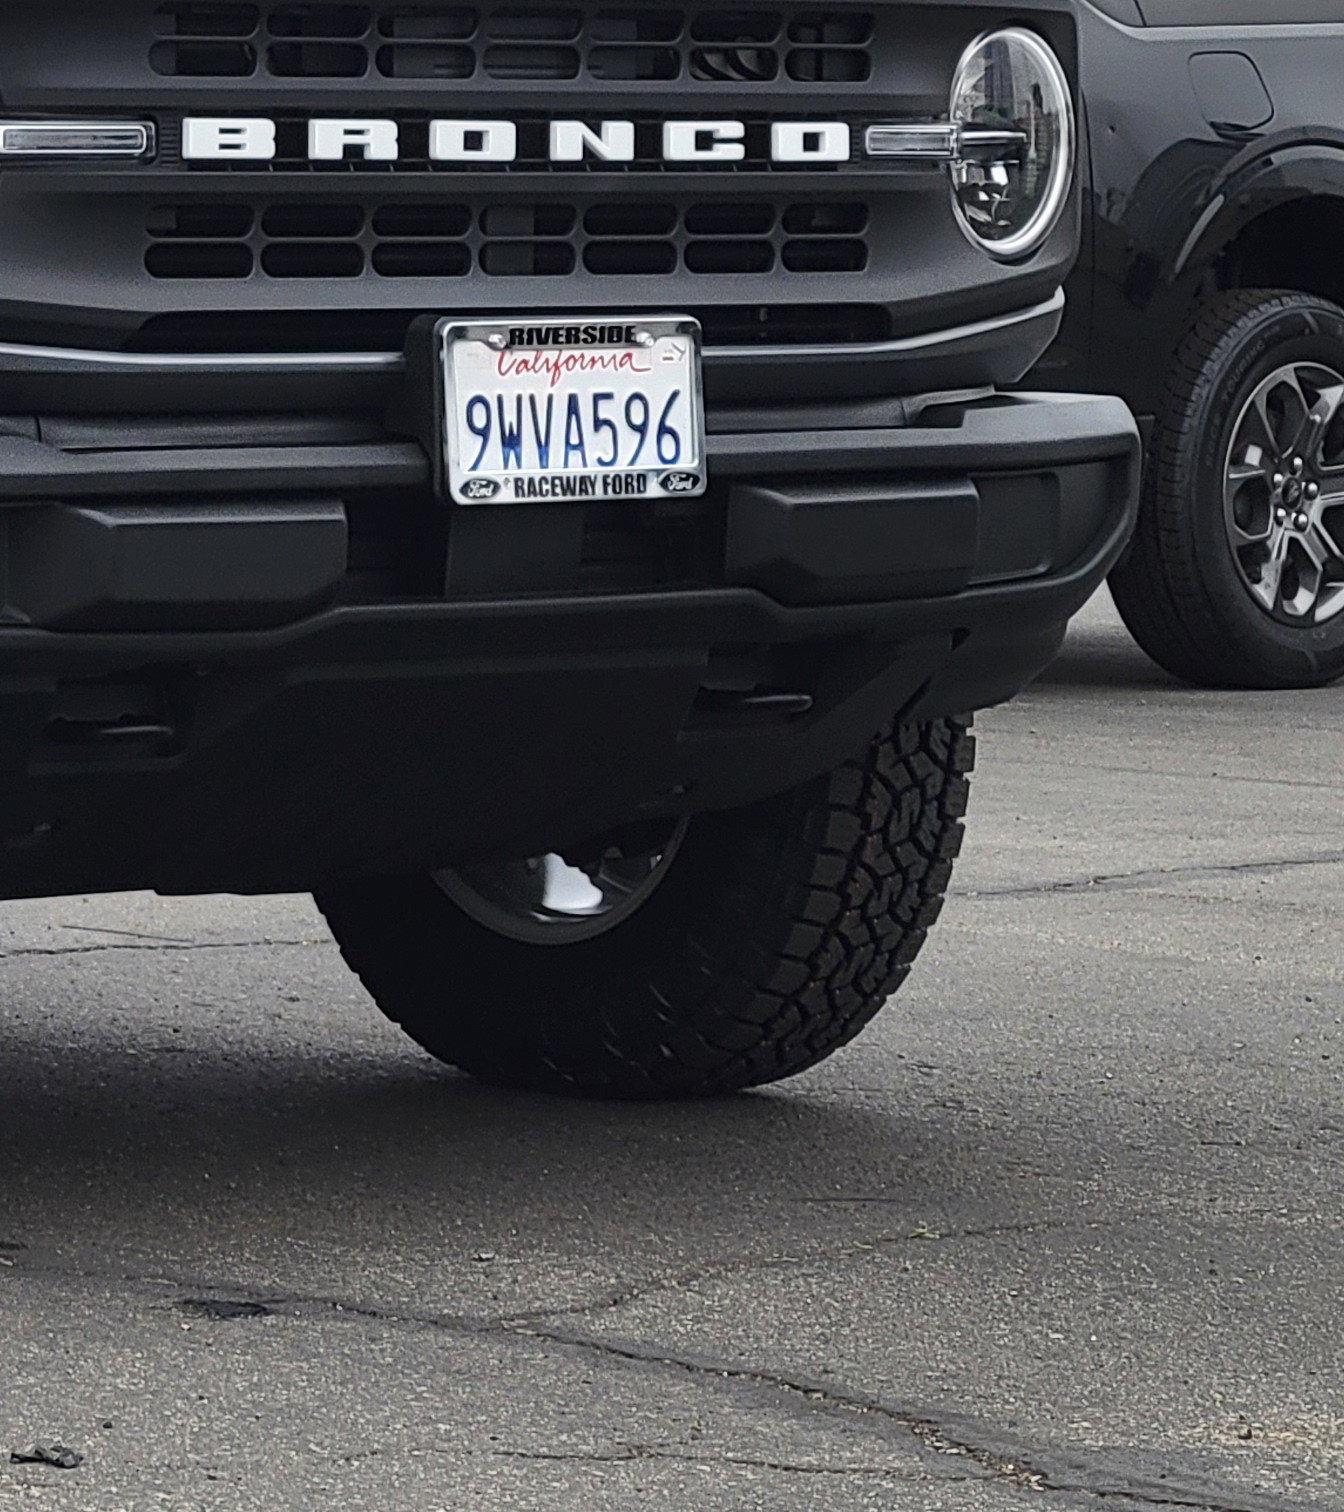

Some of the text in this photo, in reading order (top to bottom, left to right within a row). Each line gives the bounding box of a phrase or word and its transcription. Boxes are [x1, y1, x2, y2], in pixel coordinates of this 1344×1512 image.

[182, 116, 850, 162] BRONCO
[509, 325, 636, 346] RIVERSIDE
[497, 350, 651, 388] California
[465, 389, 682, 472] 9WVA596
[514, 473, 647, 499] RACEWAY FORD
